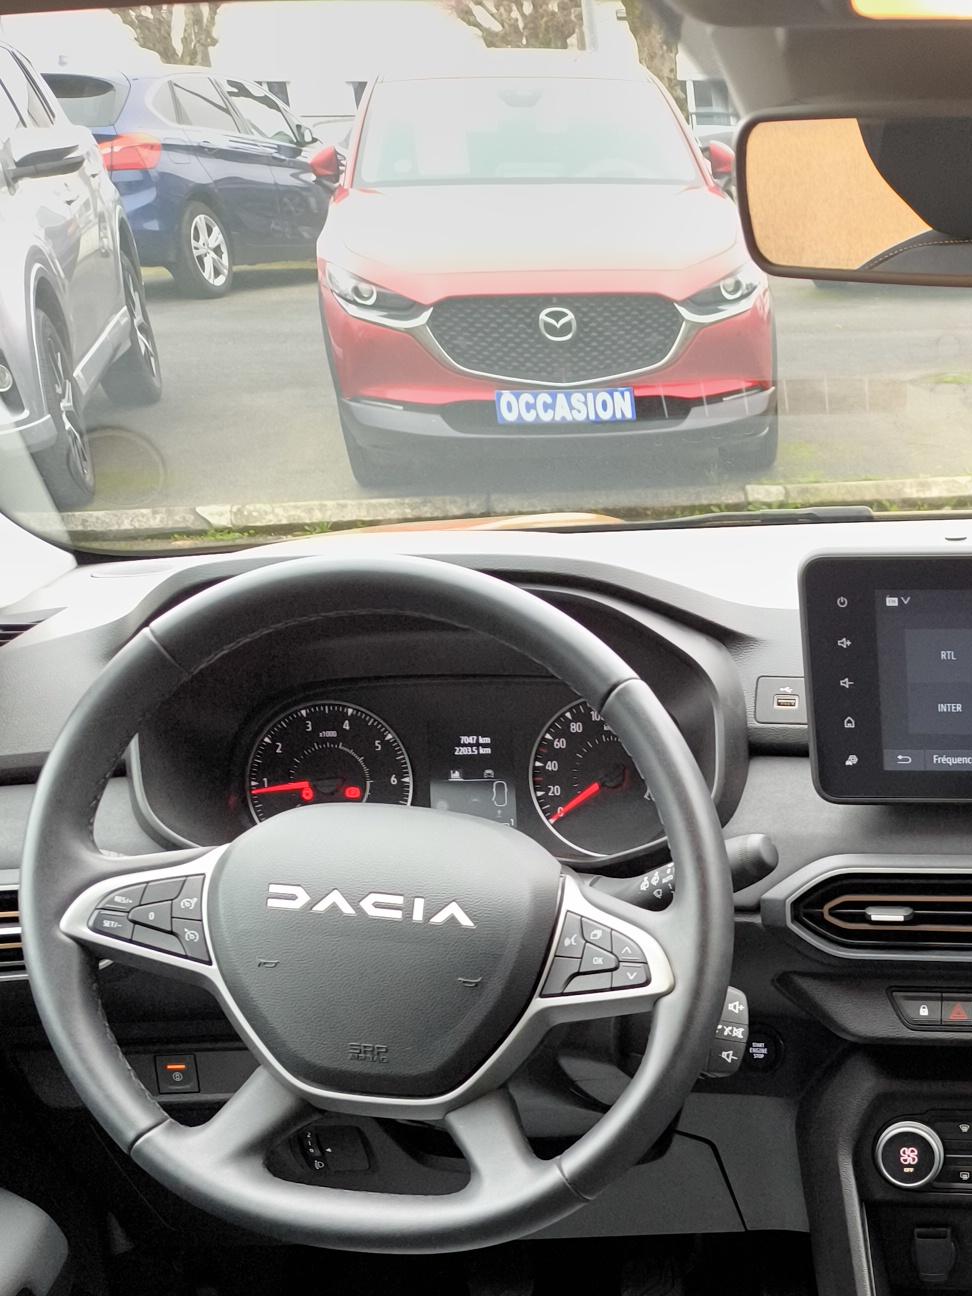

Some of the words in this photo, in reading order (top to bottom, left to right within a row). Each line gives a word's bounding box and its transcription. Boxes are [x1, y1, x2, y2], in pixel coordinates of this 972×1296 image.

[500, 391, 633, 422] OCCASION
[940, 650, 957, 660] RTL
[937, 703, 962, 713] INTER
[305, 720, 313, 732] 3
[342, 719, 350, 730] 4
[569, 722, 583, 733] 80
[479, 735, 491, 744] km
[553, 738, 567, 749] 60
[275, 742, 283, 753] 2
[375, 740, 382, 751] 5
[479, 746, 492, 754] km
[545, 761, 559, 772] 40
[262, 777, 268, 788] 1
[390, 774, 398, 785] 6
[547, 786, 561, 796] 20
[266, 883, 478, 929] DACIA
